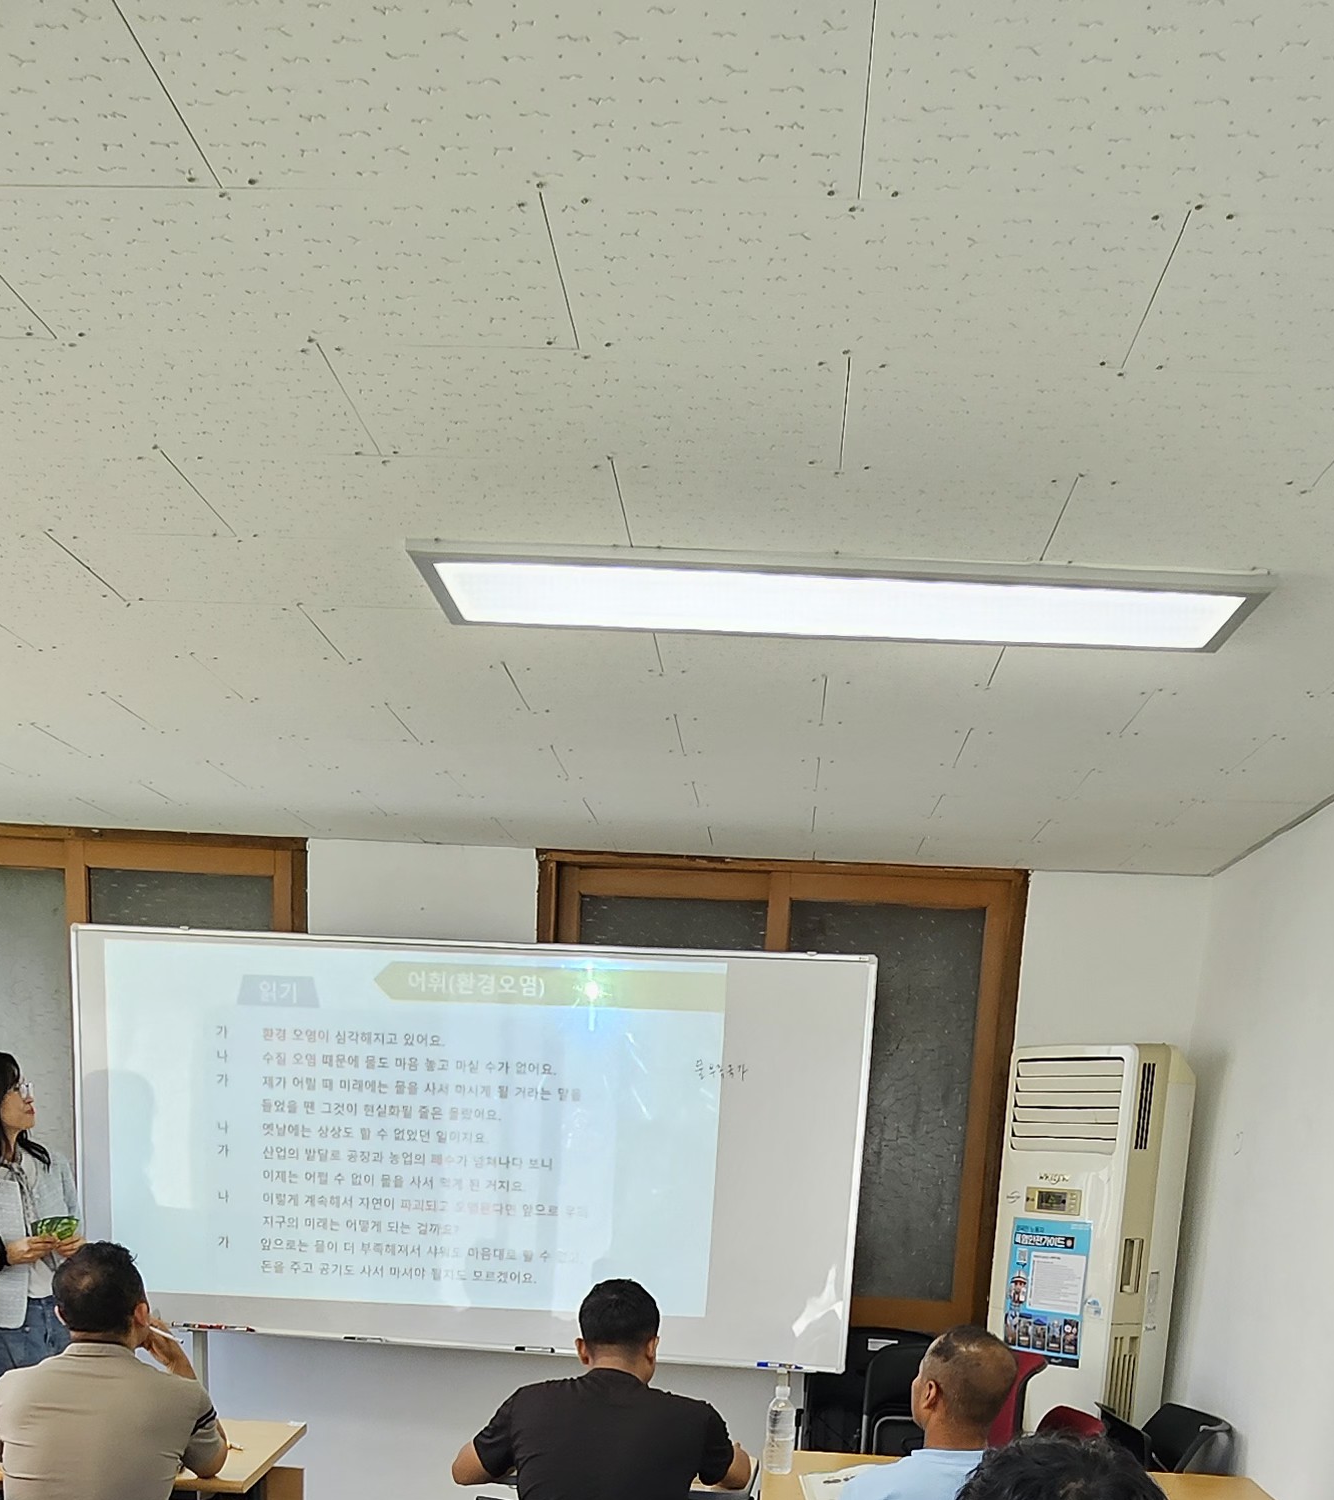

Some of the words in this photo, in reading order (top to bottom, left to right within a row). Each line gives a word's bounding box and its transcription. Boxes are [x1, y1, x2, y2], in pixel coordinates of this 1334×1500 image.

[259, 980, 298, 1004] 읽기
[408, 970, 546, 998] 어휘(환경오염)
[216, 1026, 228, 1039] 가
[262, 1028, 287, 1042] 환경
[292, 1028, 329, 1043] 오염이
[335, 1030, 398, 1046] 심각해지고
[404, 1032, 445, 1047] 있어요.
[217, 1050, 228, 1063] 나
[262, 1051, 286, 1066] 수질
[292, 1053, 316, 1067] 오염
[322, 1054, 359, 1069] 때문에
[365, 1055, 389, 1070] 물도
[395, 1056, 418, 1072] 마음
[485, 1060, 509, 1075] 수가
[516, 1060, 557, 1076] 없어요.
[216, 1074, 229, 1088] 가
[262, 1076, 287, 1090] 제가
[322, 1078, 334, 1092] 때
[339, 1079, 389, 1095] 미래에는
[424, 1082, 449, 1096] 사서
[321, 1102, 358, 1117] 그것이
[217, 1121, 228, 1134] 나
[317, 1125, 354, 1139] 상상도
[377, 1128, 388, 1142] 수
[217, 1144, 229, 1158] 가
[262, 1146, 299, 1161] 산업의
[389, 1151, 426, 1166] 농업의
[262, 1170, 299, 1185] 이제는
[334, 1172, 345, 1186] 수
[351, 1173, 374, 1188] 없이
[410, 1176, 434, 1190] 사서
[218, 1190, 229, 1203] 나
[262, 1215, 299, 1230] 지구의
[218, 1236, 229, 1249] 가
[260, 1237, 309, 1253] 앞으로는
[344, 1241, 355, 1255] 더
[290, 1261, 314, 1275] 주고
[319, 1263, 355, 1277] 공기도
[360, 1264, 384, 1279] 사서
